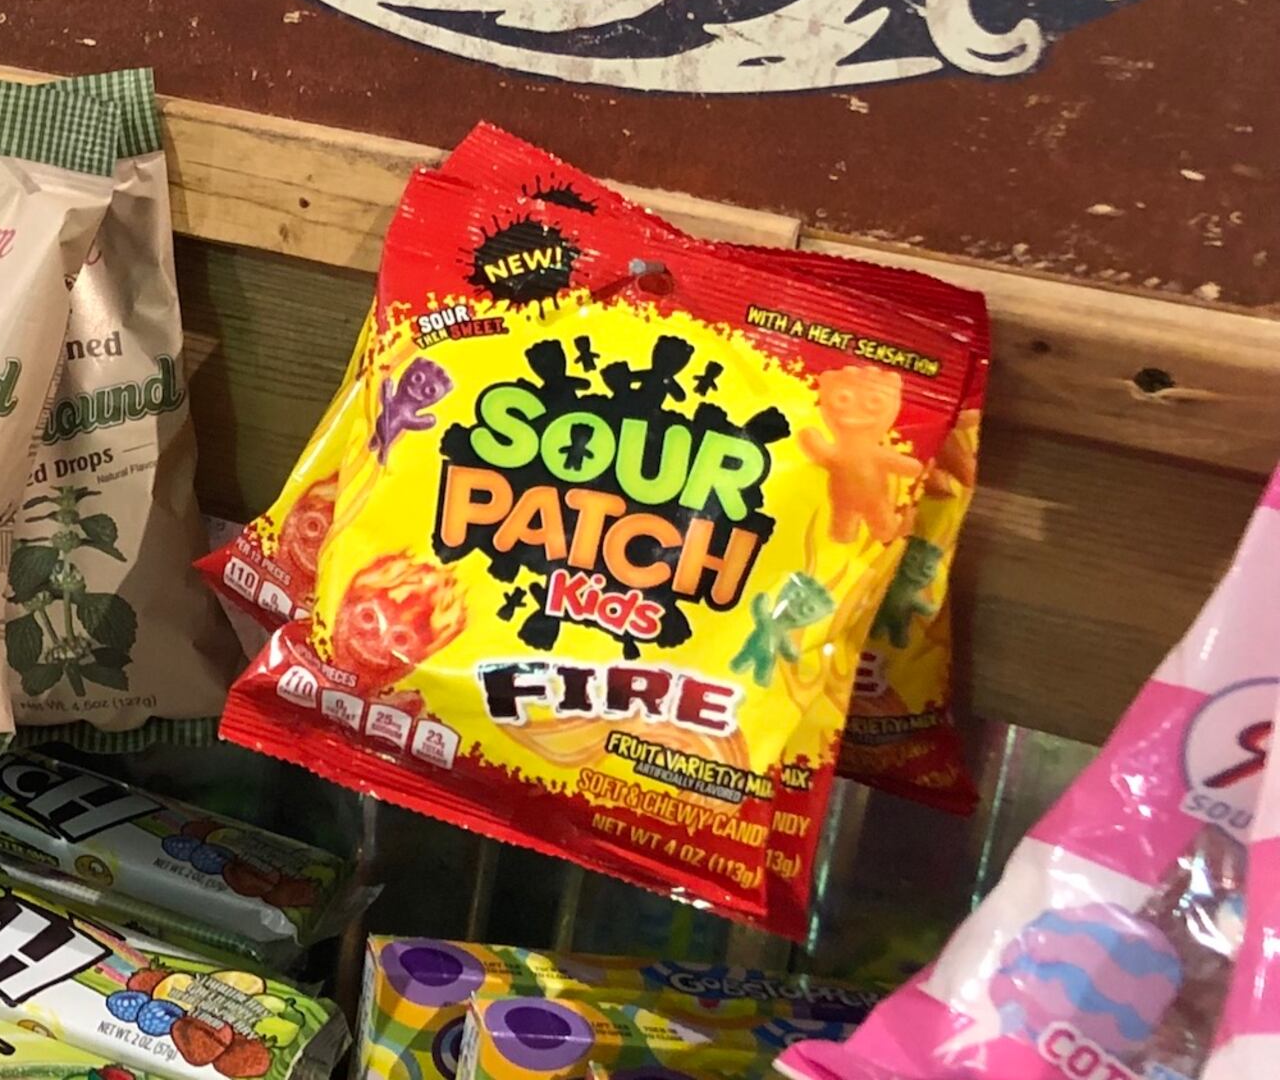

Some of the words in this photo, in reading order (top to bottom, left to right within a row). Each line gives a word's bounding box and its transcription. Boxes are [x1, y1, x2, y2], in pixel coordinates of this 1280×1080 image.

[484, 246, 564, 284] NEW!
[417, 328, 449, 350] THEN
[418, 305, 470, 333] SOUR
[748, 305, 788, 331] WITH
[790, 320, 804, 336] A
[808, 324, 852, 352] HEAT
[857, 340, 939, 378] SENSATION
[54, 447, 115, 481] Drops
[469, 385, 766, 522] SOUR
[97, 466, 130, 486] Natural
[441, 463, 761, 605] PATCH
[227, 562, 258, 590] 110
[261, 553, 291, 586] PIECES
[545, 570, 663, 639] Kids
[283, 669, 314, 698] 110
[476, 662, 739, 732] FIRE
[607, 732, 664, 765] FRUIT
[665, 749, 743, 789] VARIETY
[578, 769, 627, 801] SOFT
[625, 785, 639, 806] &
[642, 790, 712, 830] CHEWY
[636, 762, 695, 790] ARTIFICIALLY
[694, 777, 743, 803] FLAVORED
[592, 813, 628, 837] NET
[631, 828, 662, 850] WT
[664, 840, 676, 855] 4
[680, 845, 706, 866] OZ
[708, 853, 763, 889] (113g)
[97, 1021, 116, 1038] NET
[153, 1040, 178, 1062] (57g)
